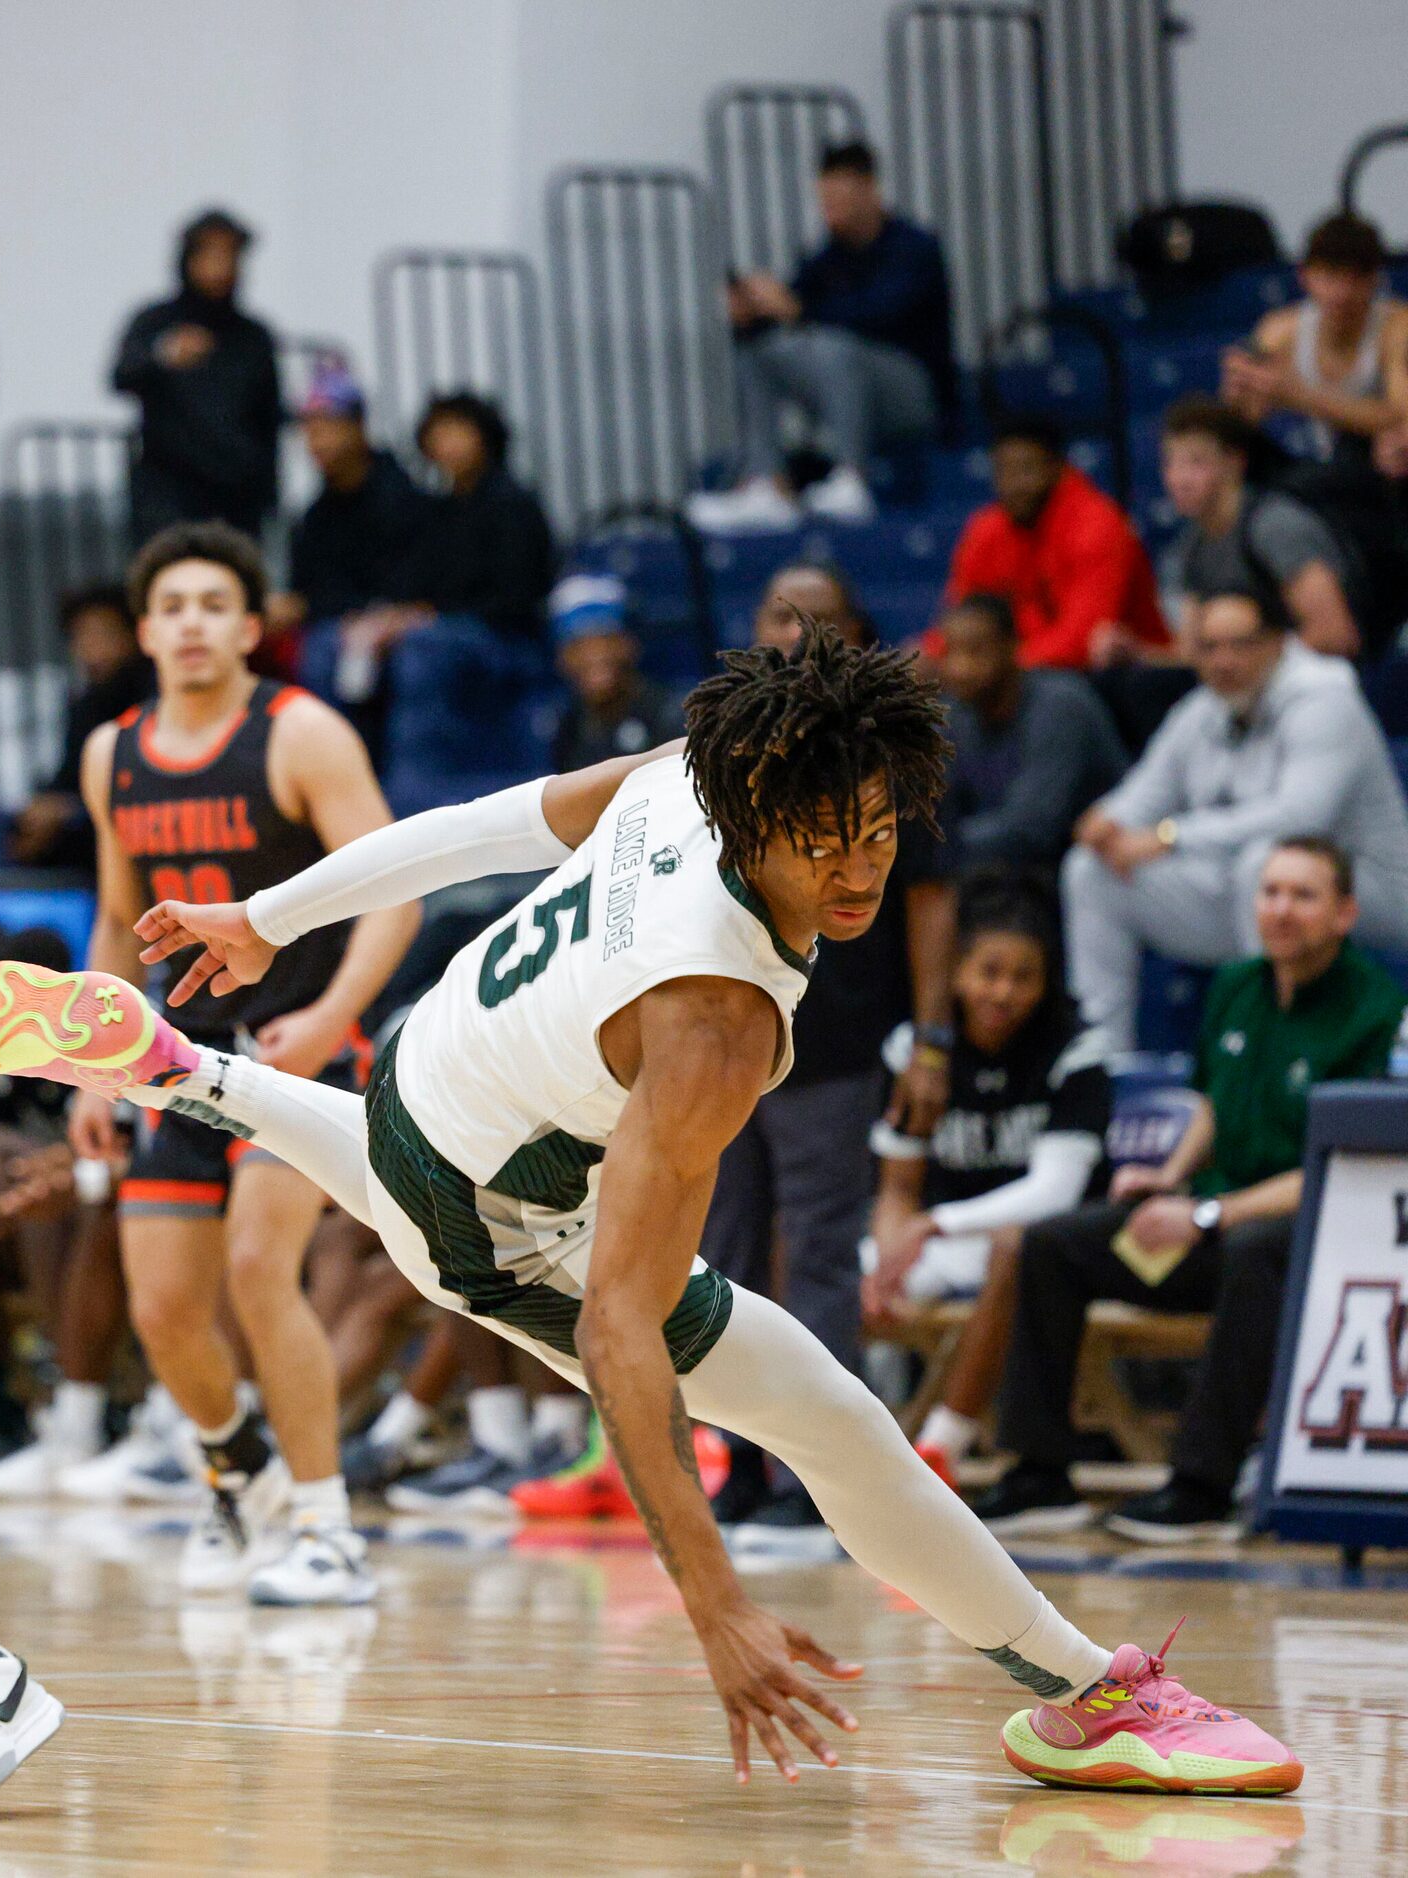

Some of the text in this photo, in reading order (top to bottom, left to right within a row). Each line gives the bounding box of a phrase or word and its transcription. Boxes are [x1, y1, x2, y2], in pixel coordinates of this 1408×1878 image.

[476, 868, 595, 1013] 5
[603, 798, 650, 962] LAKE RIDGE
